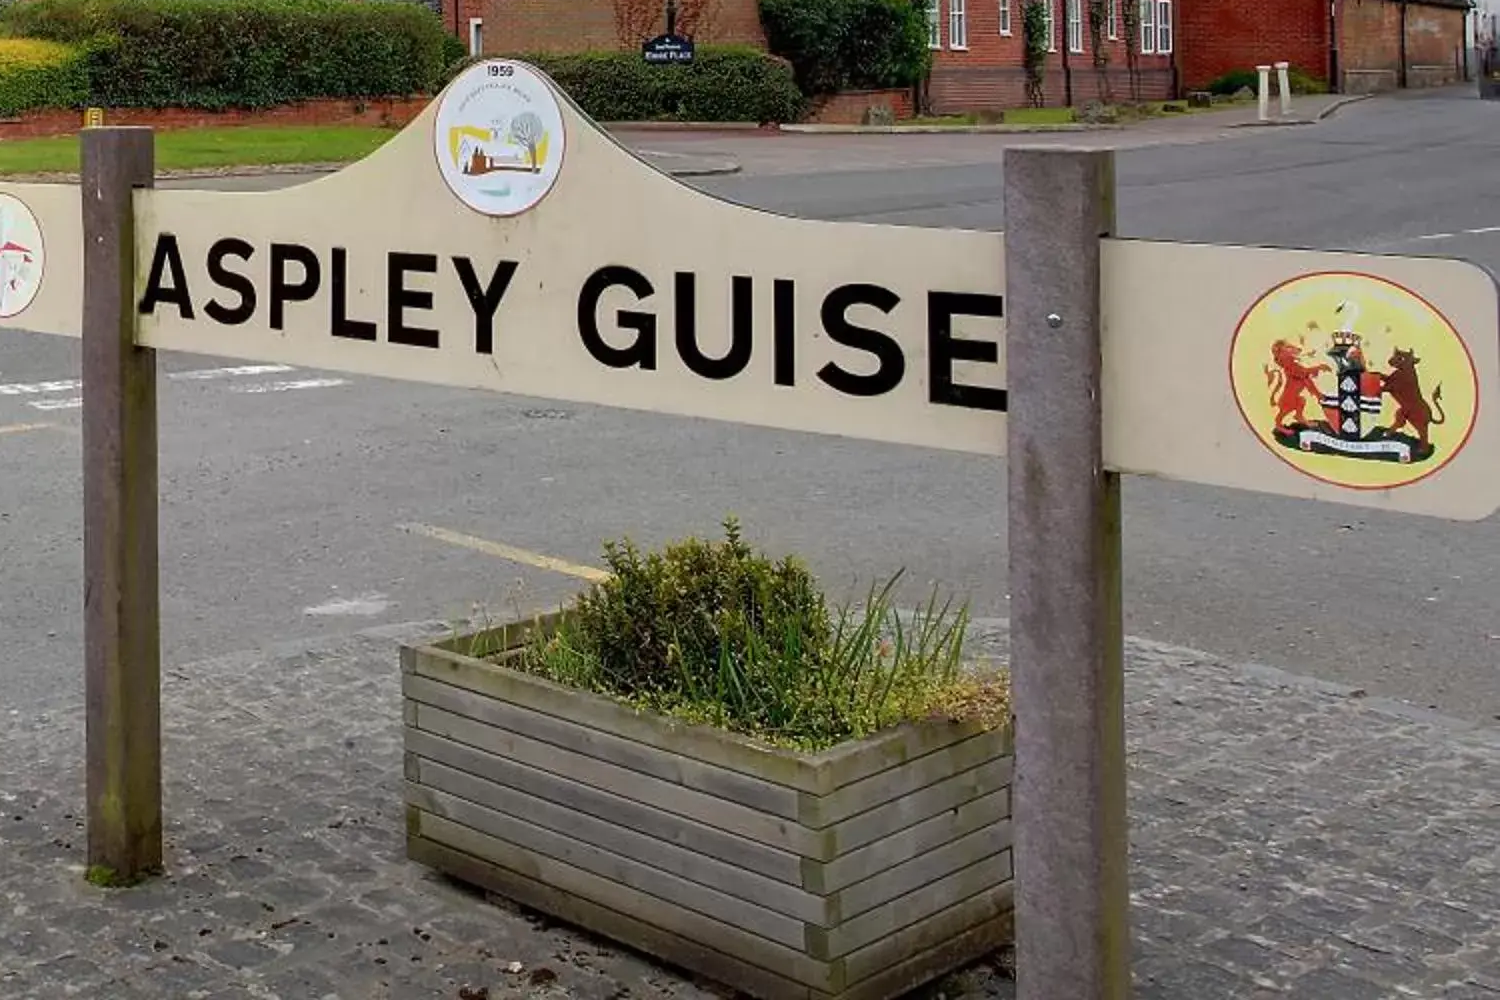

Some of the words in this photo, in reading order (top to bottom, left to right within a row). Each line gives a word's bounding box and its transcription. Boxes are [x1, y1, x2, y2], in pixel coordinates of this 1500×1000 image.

[487, 65, 514, 77] 1959
[138, 231, 519, 356] ASPLEY
[576, 265, 1006, 412] GUISE
